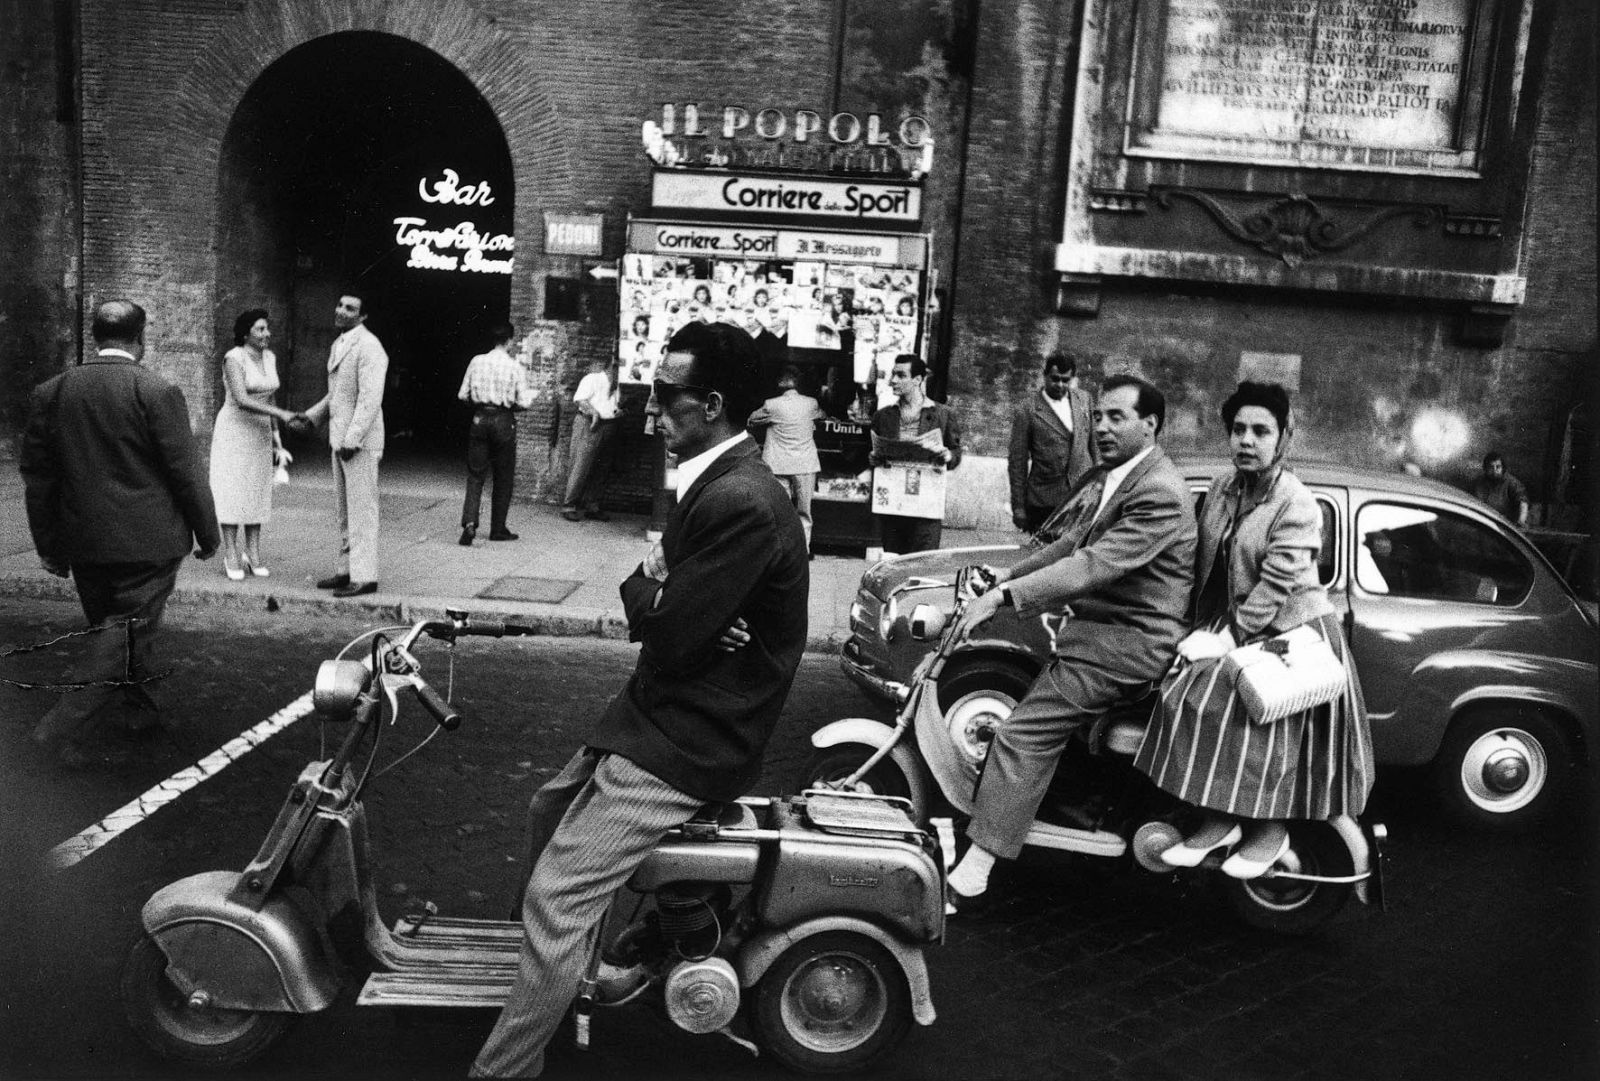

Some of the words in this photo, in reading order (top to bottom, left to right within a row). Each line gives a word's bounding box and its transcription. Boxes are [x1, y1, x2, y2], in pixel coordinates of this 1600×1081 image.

[1388, 46, 1430, 58] LIGNIS
[1321, 89, 1369, 106] CARD
[662, 103, 709, 136] IL
[723, 106, 931, 147] POPOLO
[418, 167, 495, 207] Bar
[723, 178, 822, 210] Corriere
[844, 185, 910, 217] Sport
[658, 230, 720, 250] Corriere
[733, 233, 779, 253] Sport
